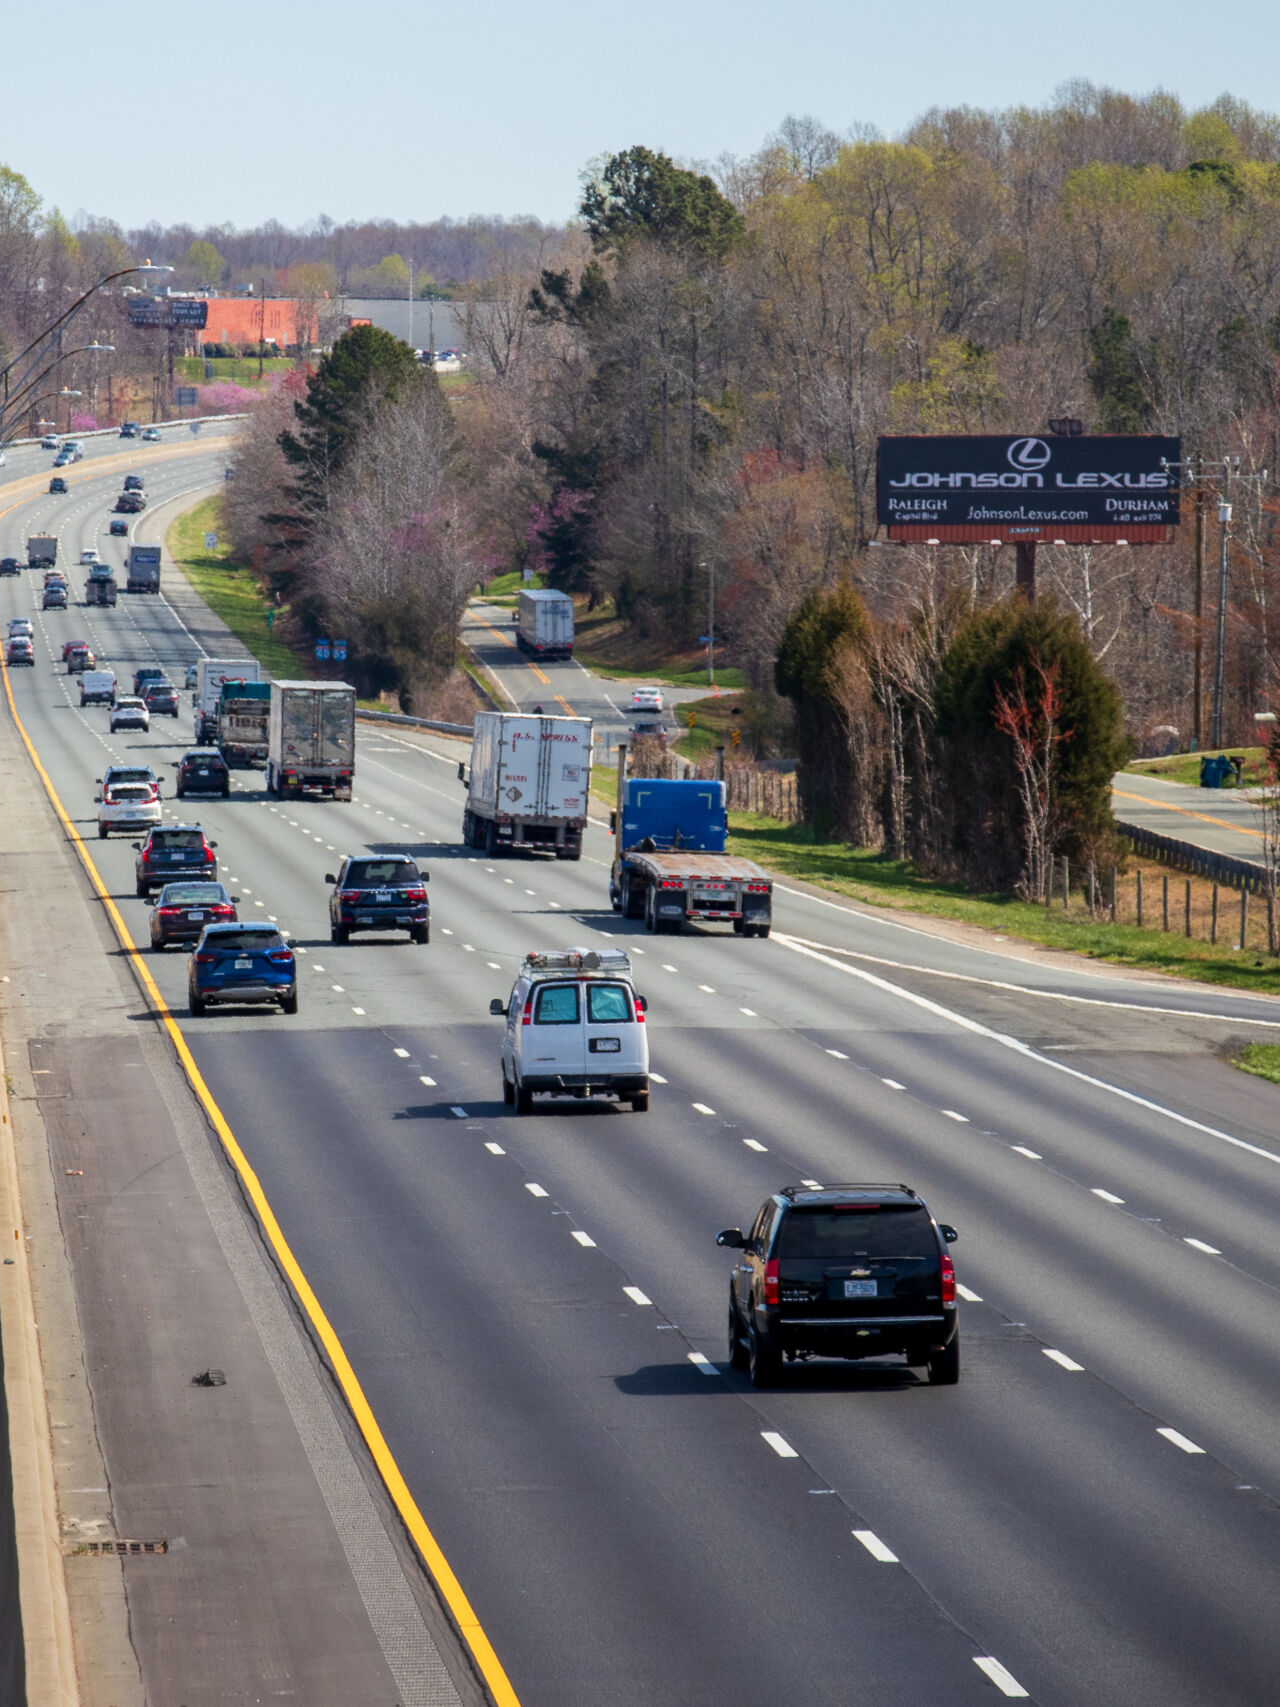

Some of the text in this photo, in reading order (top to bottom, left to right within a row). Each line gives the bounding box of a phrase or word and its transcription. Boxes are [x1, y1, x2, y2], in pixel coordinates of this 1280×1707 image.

[889, 472, 1168, 488] JOHNSON LEXUS
[888, 498, 948, 510] RALEIGH
[1105, 498, 1169, 511] DURHAM
[895, 512, 921, 520] Capital
[966, 505, 1089, 521] JohnsonLexus.com
